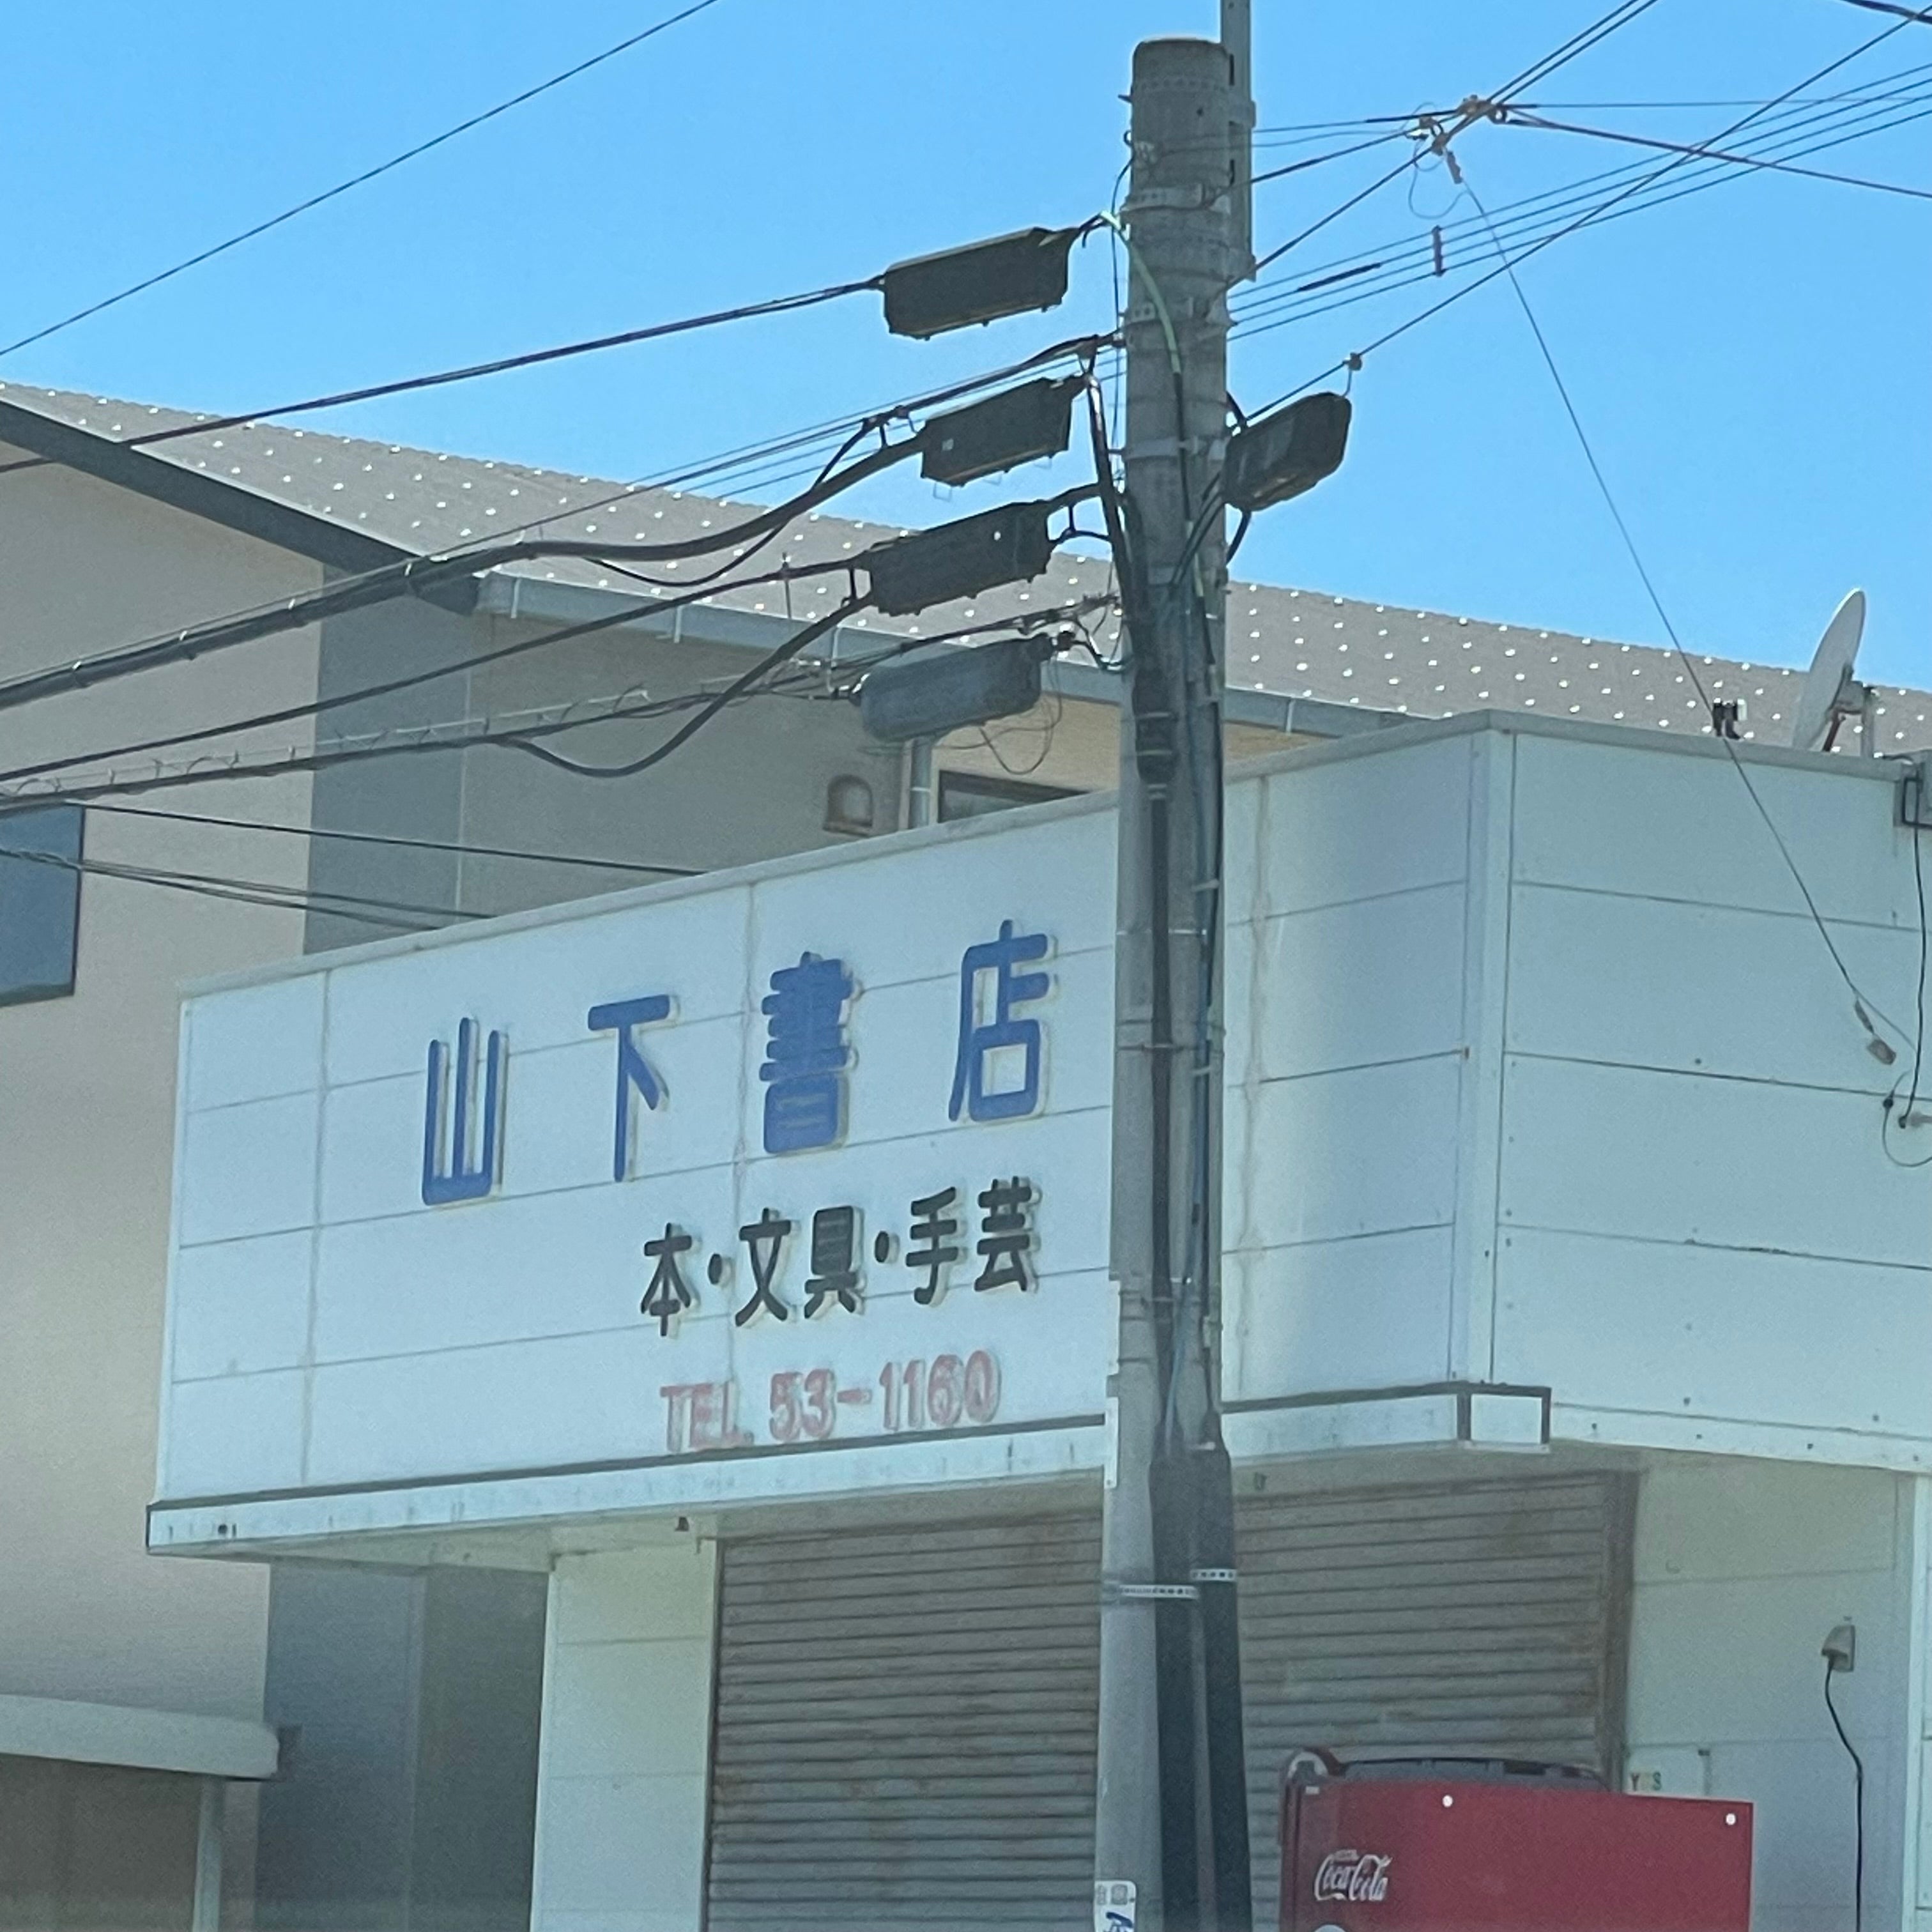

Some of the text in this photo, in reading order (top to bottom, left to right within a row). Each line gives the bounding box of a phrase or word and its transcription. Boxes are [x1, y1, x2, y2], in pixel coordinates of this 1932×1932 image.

[422, 920, 1054, 1206] 山下書店
[769, 1349, 1001, 1443] 53-1160
